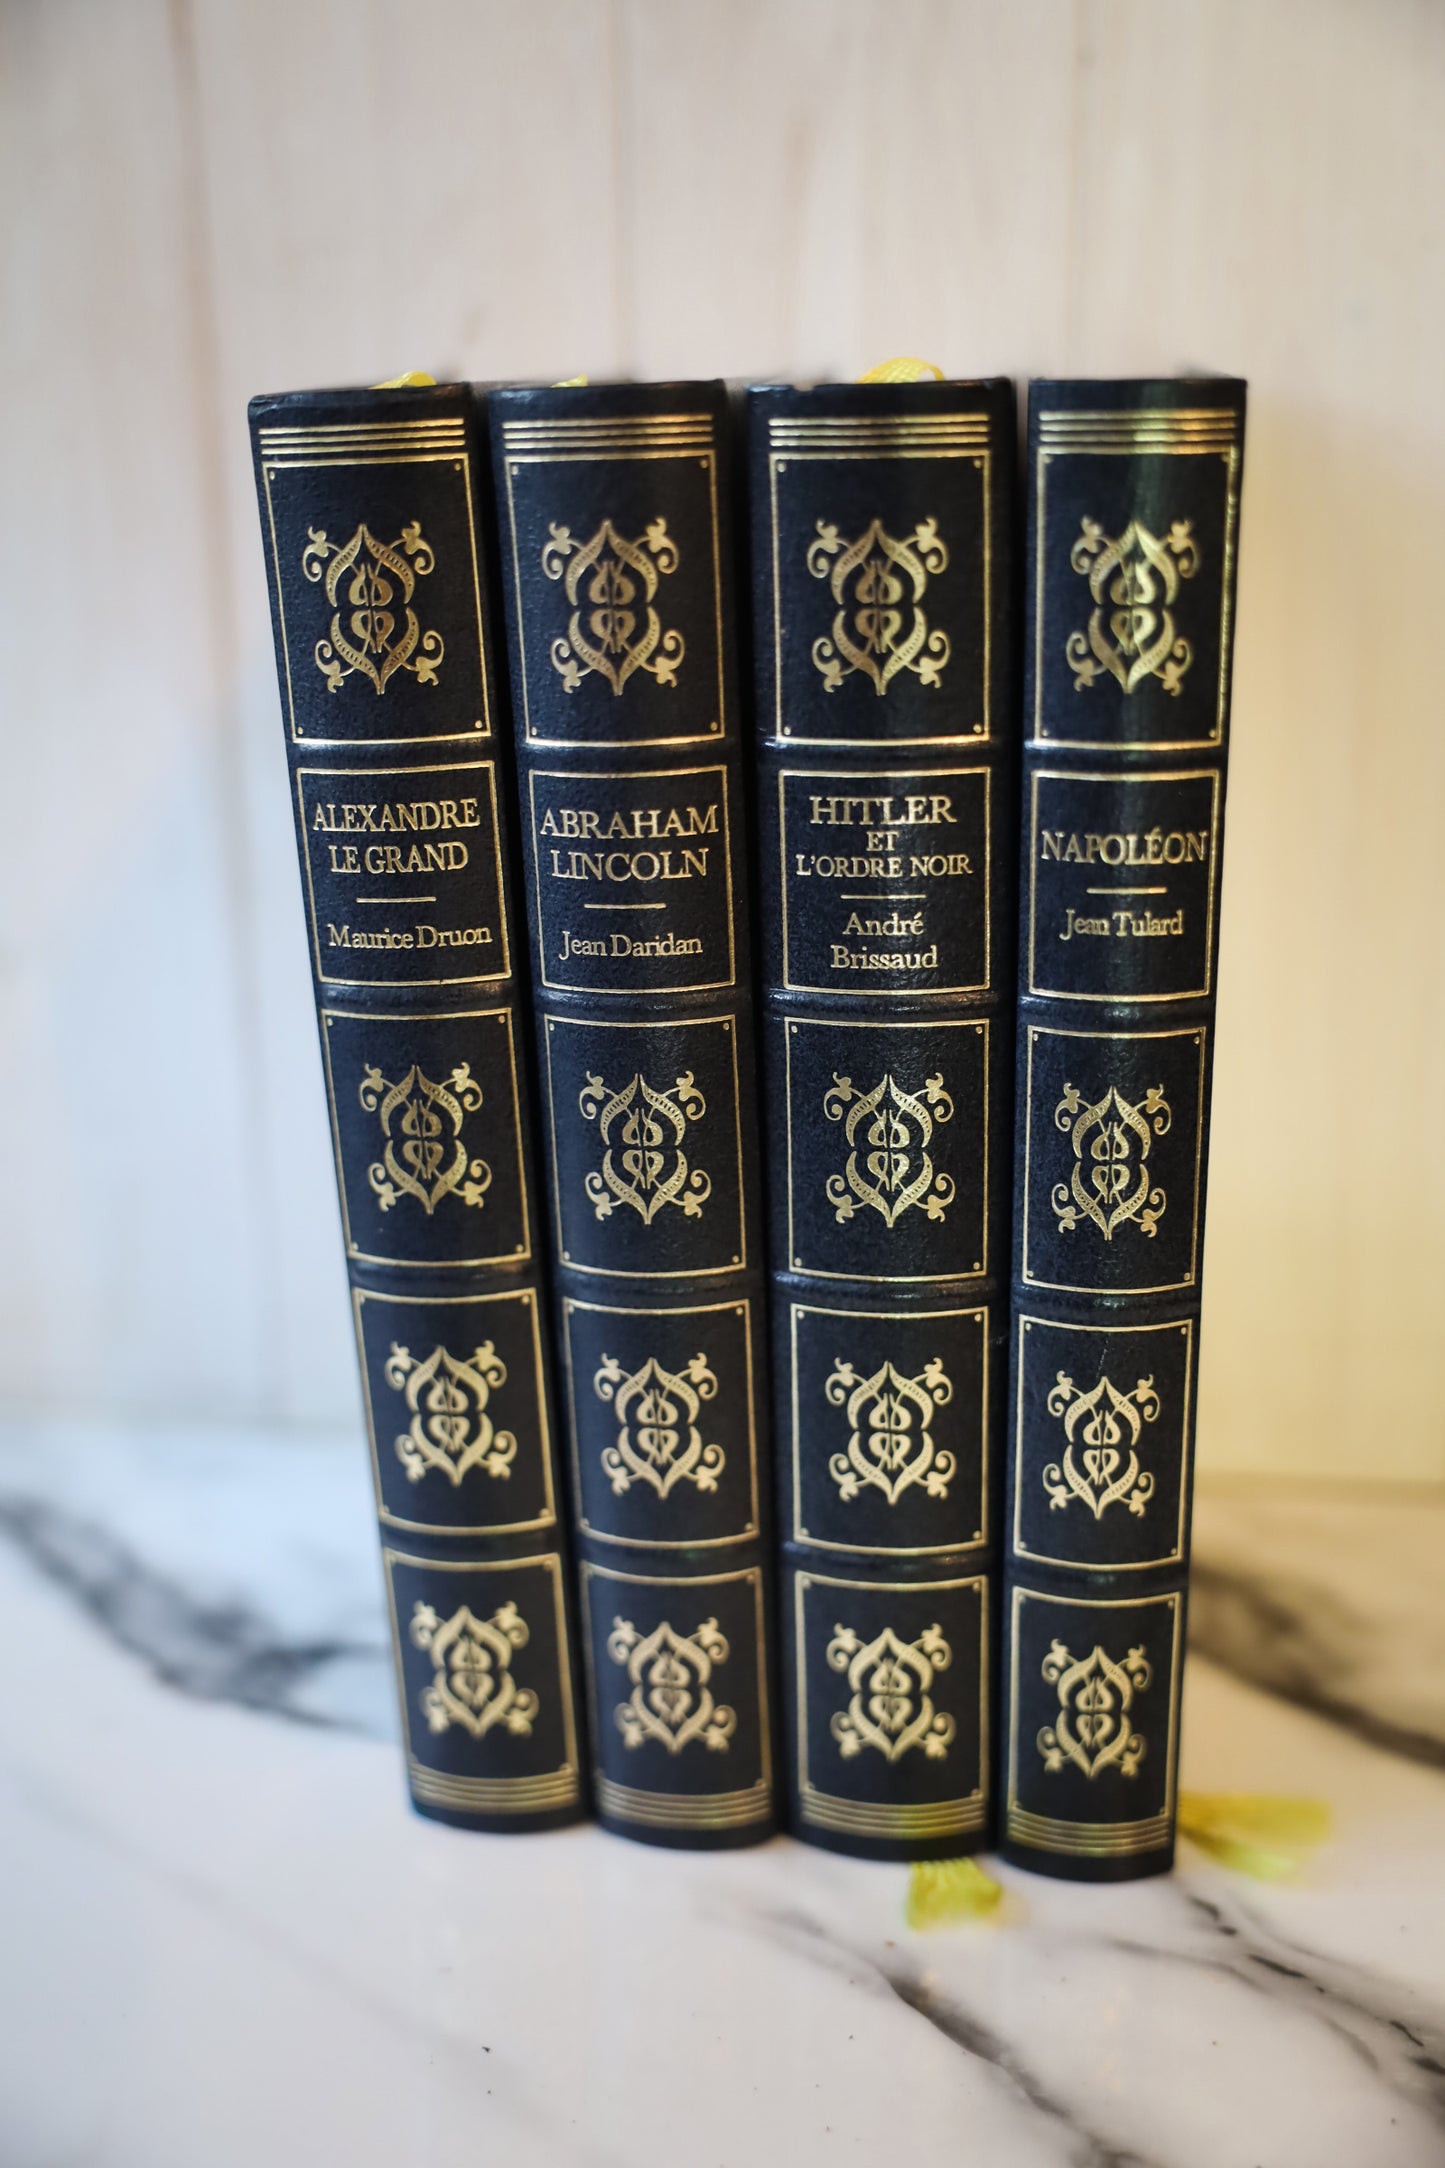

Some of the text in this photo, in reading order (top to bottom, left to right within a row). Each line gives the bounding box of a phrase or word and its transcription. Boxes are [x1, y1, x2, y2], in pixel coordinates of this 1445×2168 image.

[312, 797, 481, 832] ALEXANDRE
[539, 804, 719, 839] ABRAHAM
[808, 795, 958, 826] HITLER
[866, 830, 900, 852] ET
[1040, 825, 1208, 866] NAPOLÉON
[328, 841, 470, 875] LE GRAND
[550, 847, 709, 882] LINCOLN
[795, 853, 974, 878] L'ORDRE NOIR
[326, 923, 494, 950] Maurice Druon
[841, 911, 924, 937] André
[1058, 908, 1184, 942] Jean Tulard
[558, 930, 704, 961] Jean Daridan
[829, 944, 939, 970] Brissaud
